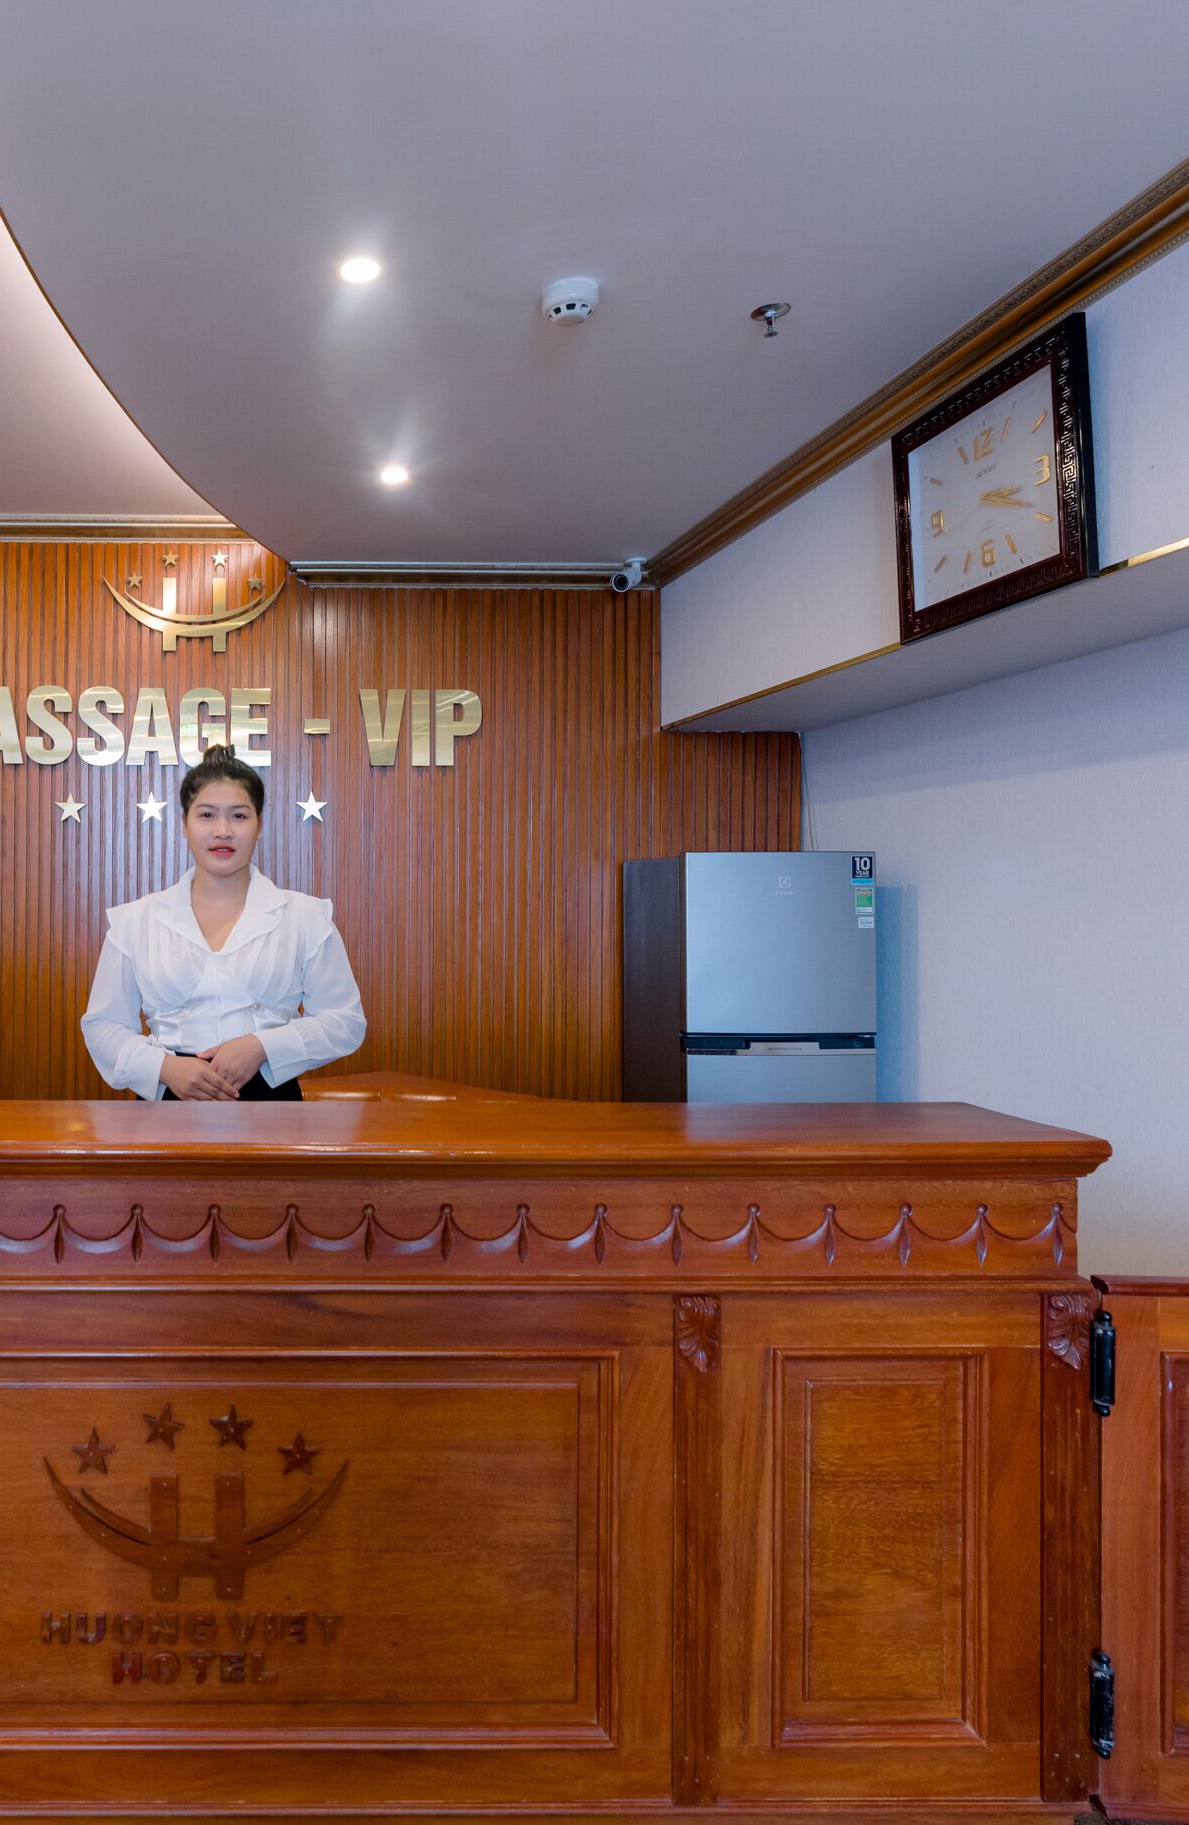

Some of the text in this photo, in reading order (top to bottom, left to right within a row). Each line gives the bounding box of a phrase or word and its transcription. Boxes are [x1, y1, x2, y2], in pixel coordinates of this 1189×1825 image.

[973, 426, 995, 462] 12
[1034, 453, 1051, 487] 3
[930, 510, 945, 538] 9
[981, 538, 997, 568] 6
[359, 688, 483, 768] VIP
[854, 857, 871, 870] 10
[111, 1650, 279, 1685] HOTEL
